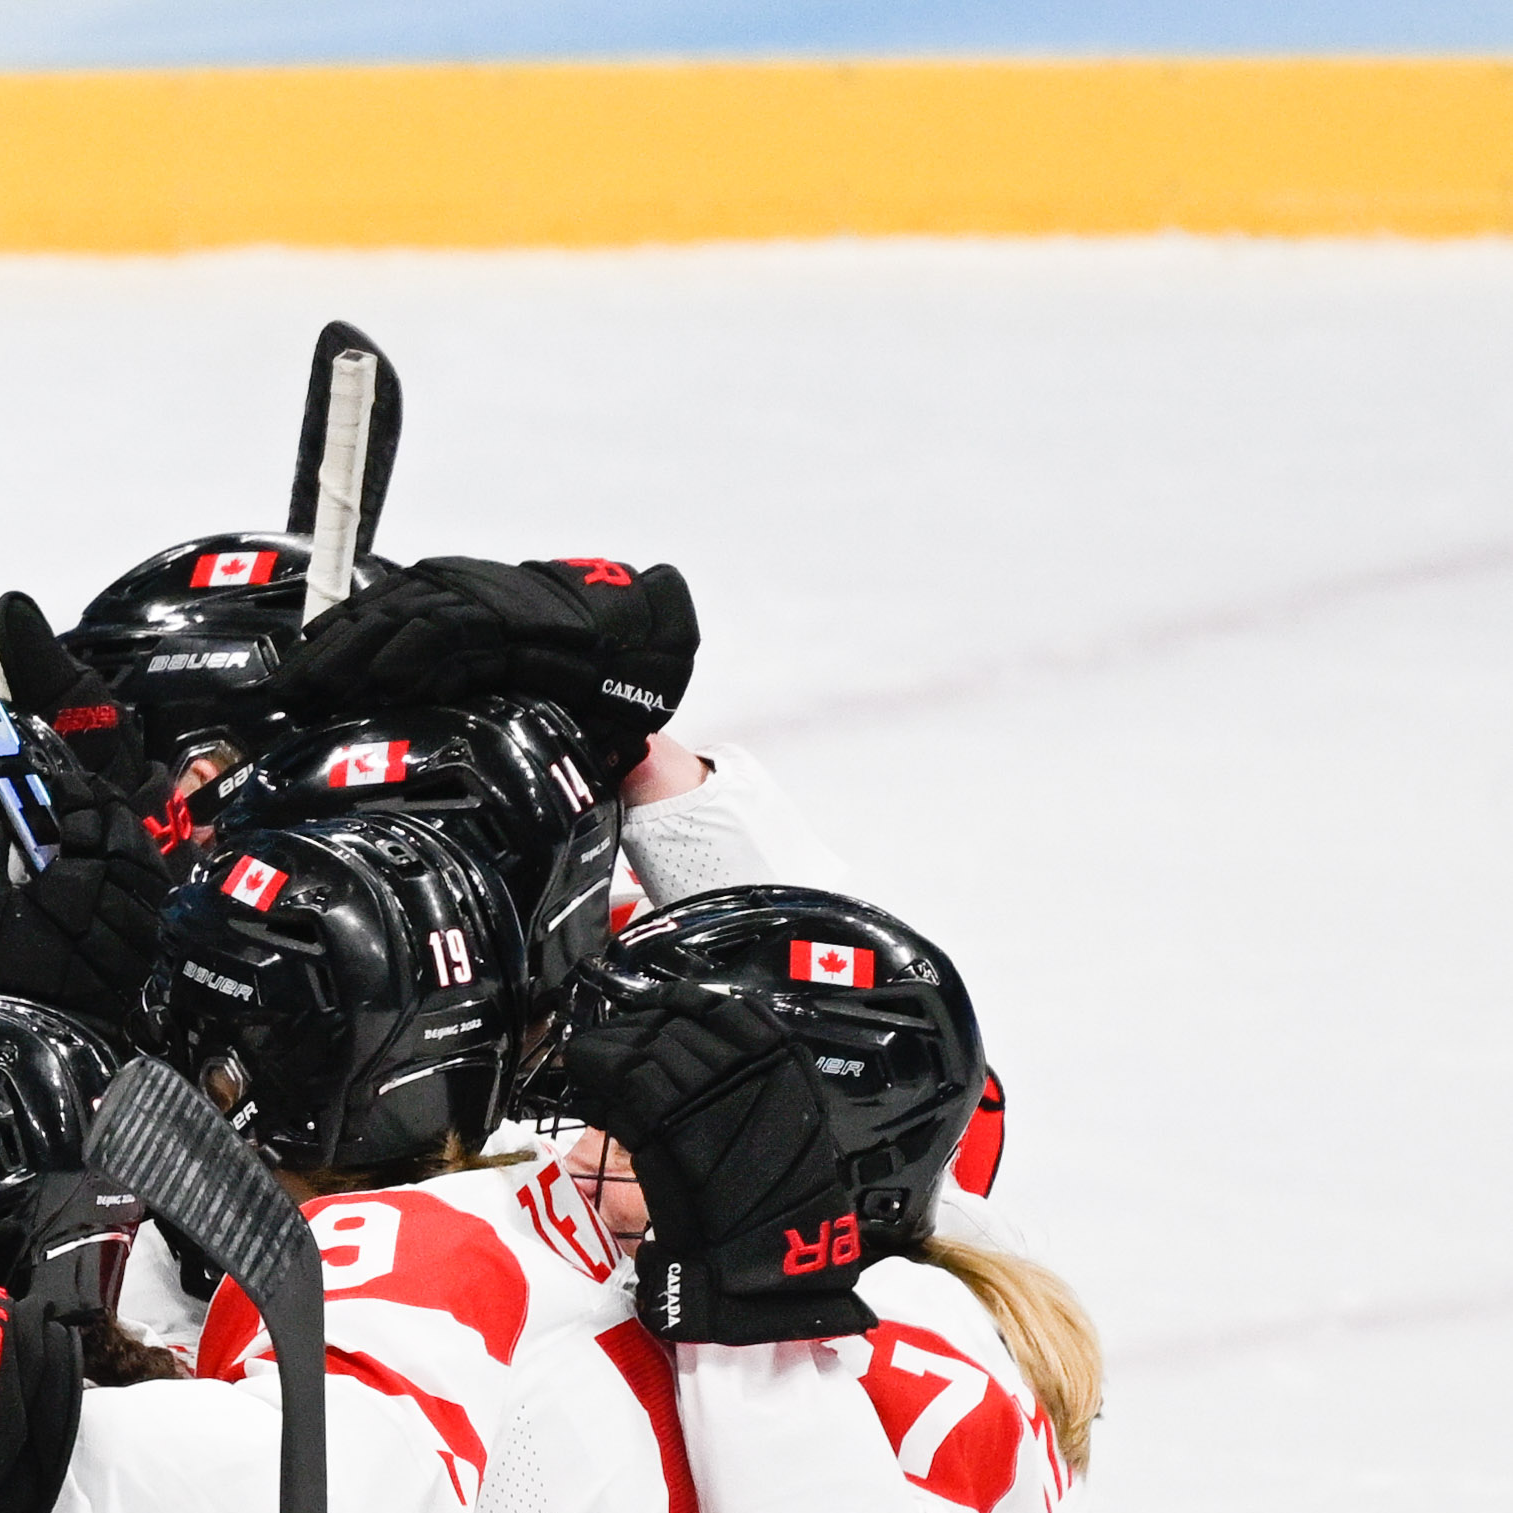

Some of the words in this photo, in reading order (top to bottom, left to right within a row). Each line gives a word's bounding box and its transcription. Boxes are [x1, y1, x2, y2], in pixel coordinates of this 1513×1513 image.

[147, 652, 250, 673] BAUER
[602, 679, 666, 711] CANADA
[428, 928, 472, 988] 19
[182, 959, 254, 1001] BAUER
[666, 1261, 682, 1329] CANADA
